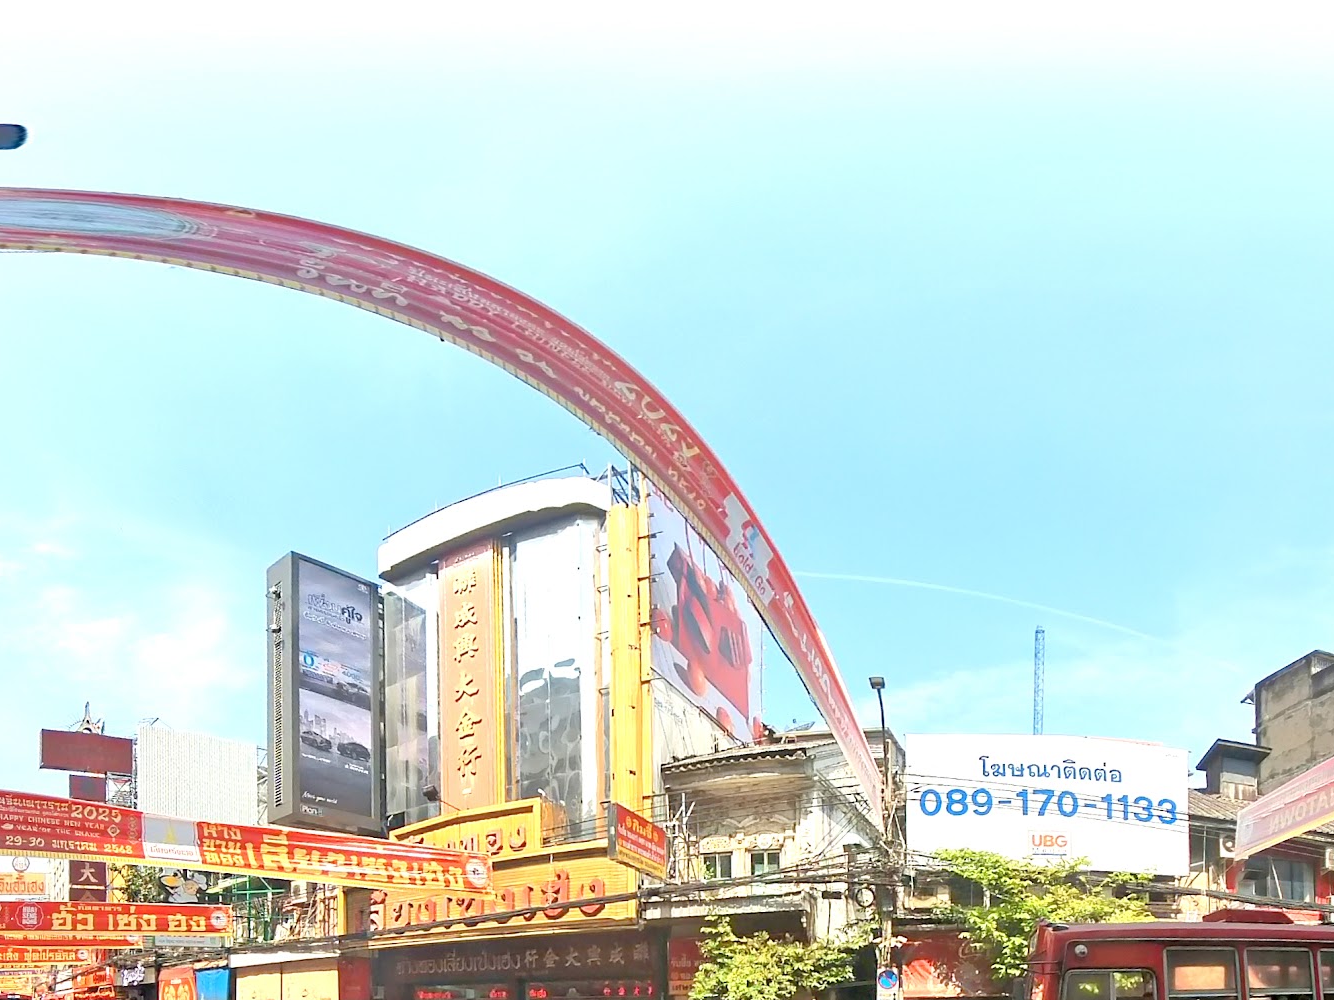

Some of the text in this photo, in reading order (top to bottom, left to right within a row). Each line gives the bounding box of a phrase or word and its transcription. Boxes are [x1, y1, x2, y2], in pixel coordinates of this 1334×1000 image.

[979, 756, 1123, 783] โฆษณาติดต่อ
[70, 804, 122, 823] 2025
[919, 788, 1178, 825] 089-170-1133
[16, 824, 38, 832] YEAR
[55, 827, 72, 835] THE
[27, 815, 62, 826] CHINESE
[64, 818, 81, 827] NEW
[84, 821, 105, 830] YEAR
[5, 836, 45, 848] 29-30
[104, 843, 133, 855] 2568
[1031, 834, 1068, 848] UBG
[78, 862, 100, 883] 大
[167, 912, 207, 932] ฮง
